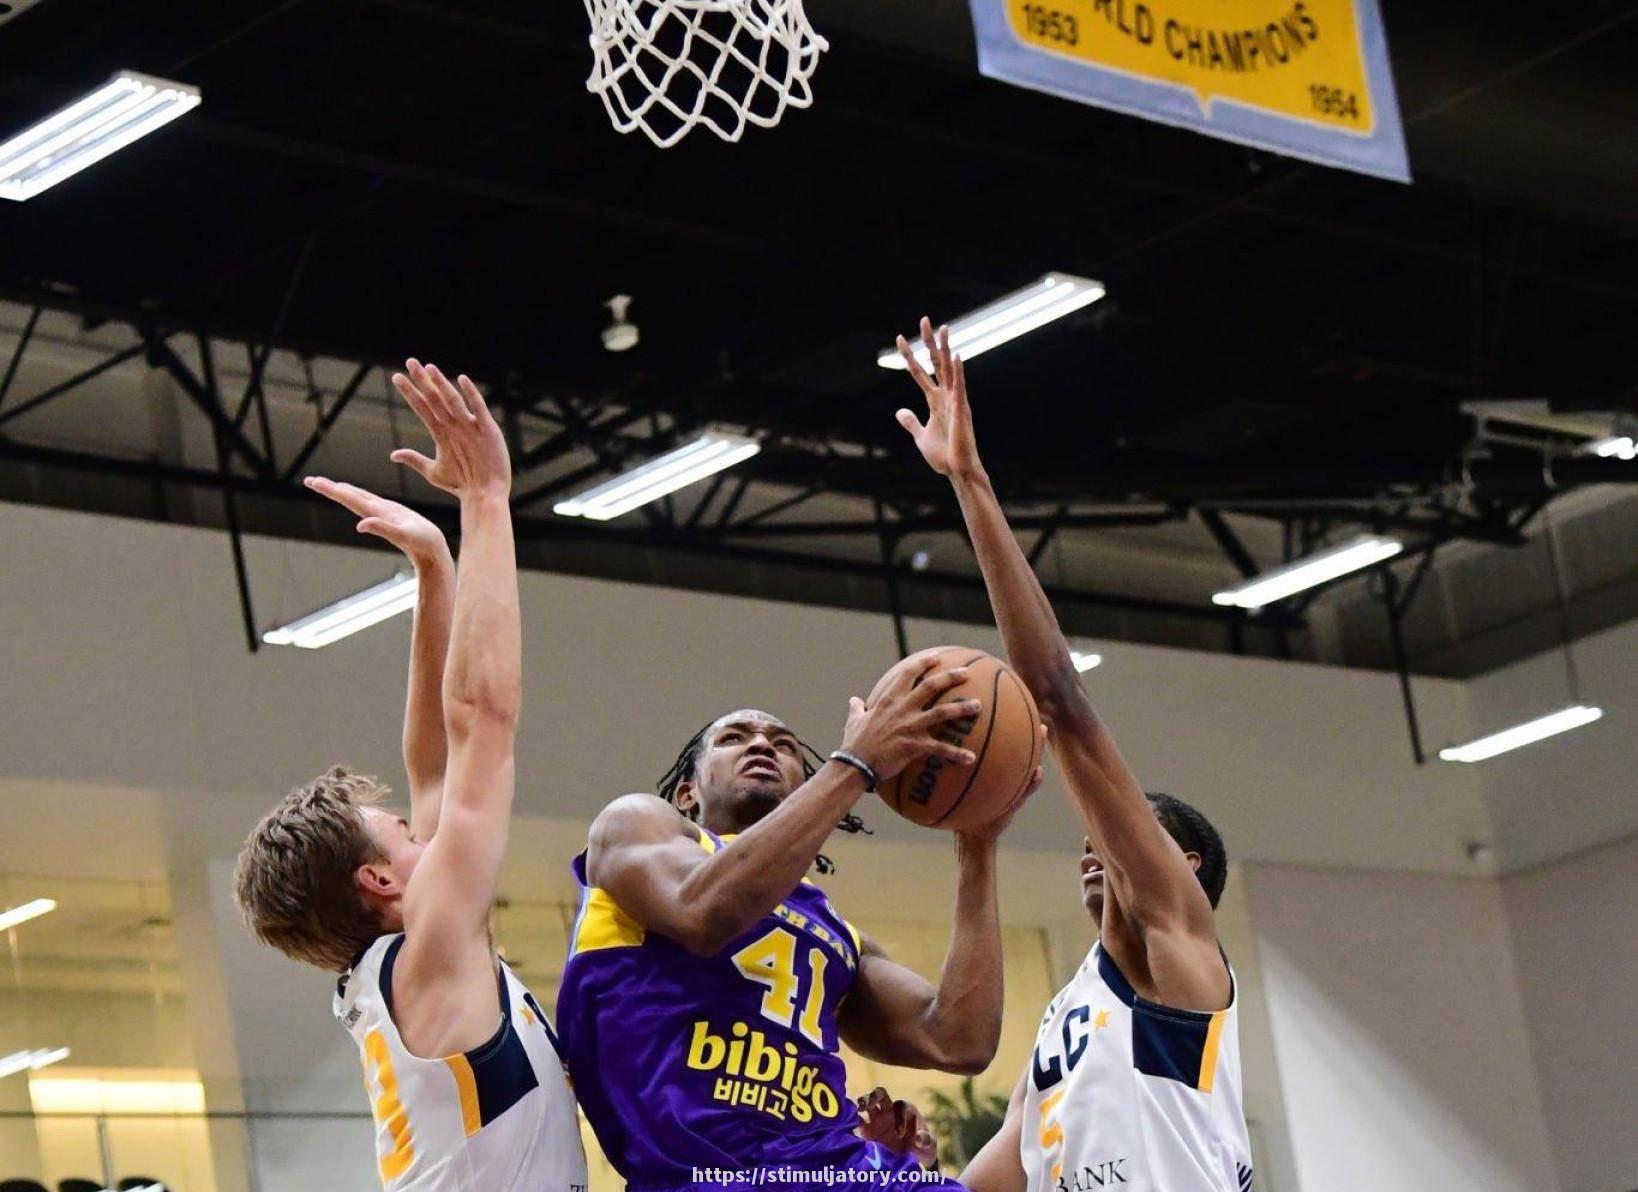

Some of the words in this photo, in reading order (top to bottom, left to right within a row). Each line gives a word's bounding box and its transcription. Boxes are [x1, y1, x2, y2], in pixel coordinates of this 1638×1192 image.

[1022, 3, 1079, 46] 1953
[1095, 0, 1154, 45] RLD
[1164, 2, 1319, 72] CHAMPIONS
[1308, 84, 1359, 119] 1954
[730, 926, 830, 1051] 41
[686, 1020, 840, 1123] bibigo
[713, 1077, 788, 1121] 비비고
